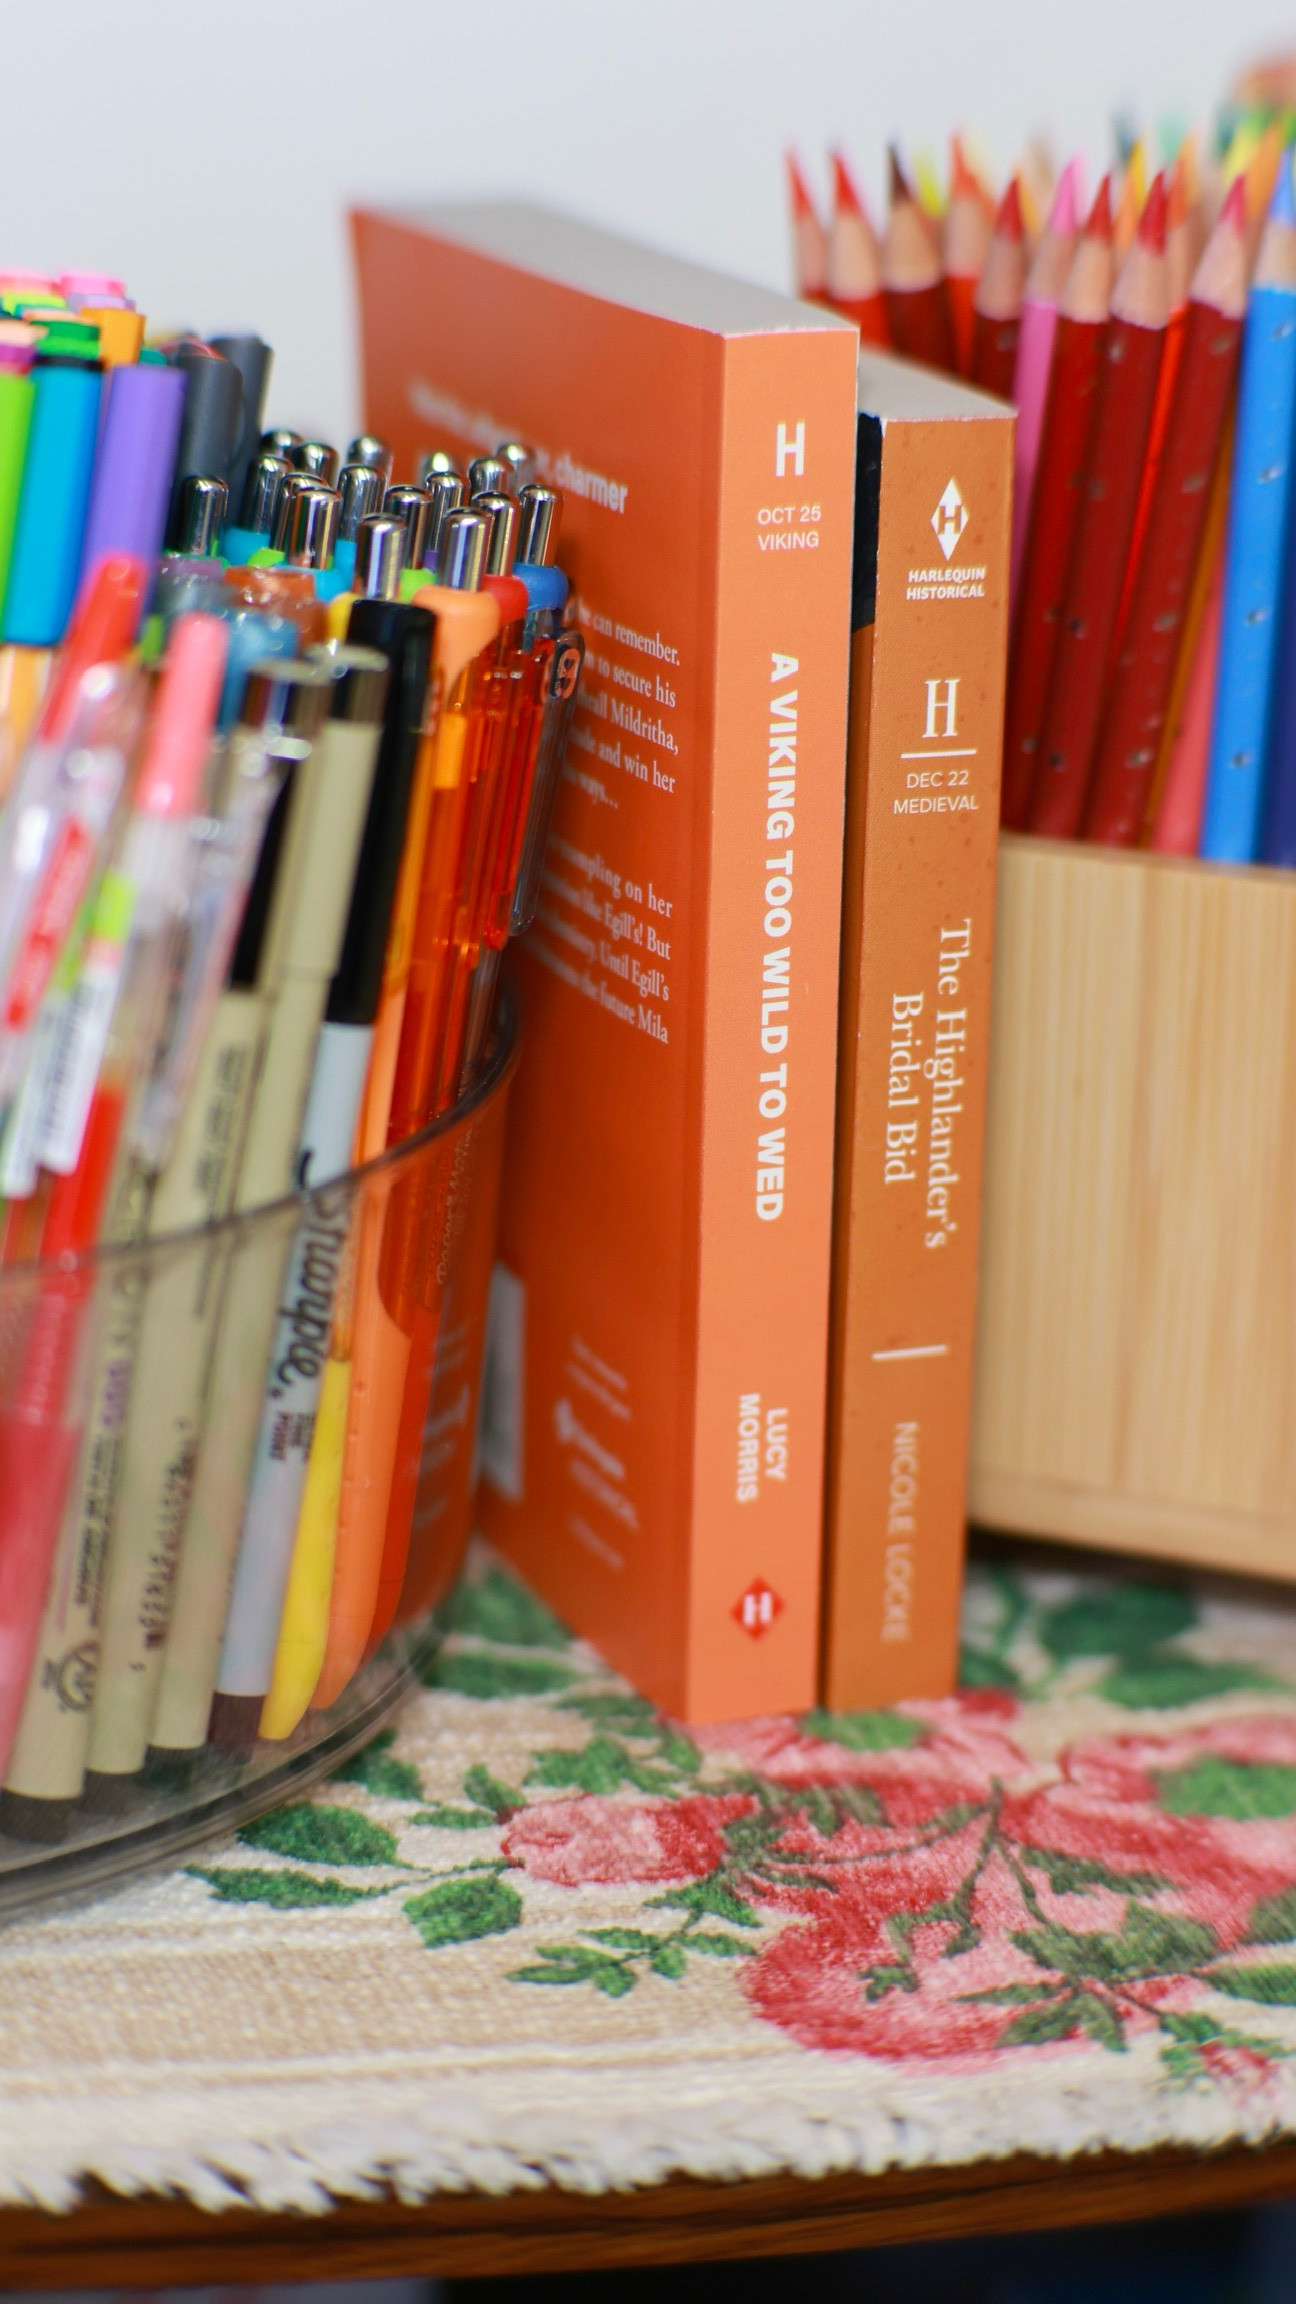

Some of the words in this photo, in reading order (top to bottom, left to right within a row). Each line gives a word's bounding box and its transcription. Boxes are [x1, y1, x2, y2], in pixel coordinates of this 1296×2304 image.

[776, 423, 806, 478] H
[553, 449, 629, 514] charmer
[757, 507, 794, 527] OCT
[800, 506, 822, 524] 25
[757, 532, 820, 553] VIKING
[937, 504, 965, 537] H
[906, 585, 985, 602] HISTORICAL
[908, 567, 986, 585] HARLEQUIN
[593, 612, 613, 637] can
[615, 624, 681, 667] remember.
[771, 652, 799, 683] A
[613, 662, 653, 698] secure
[655, 675, 677, 708] his
[922, 678, 960, 740] H
[611, 699, 679, 755] Mildritha,
[600, 742, 621, 769] and
[624, 754, 650, 783] win
[653, 760, 676, 794] her
[767, 690, 799, 841] VIKING
[906, 772, 943, 790] DEC
[948, 770, 970, 788] 22
[893, 795, 979, 815] MEDIEVAL
[624, 878, 643, 904] on
[648, 883, 674, 918] her
[764, 850, 794, 938] TOO
[599, 938, 630, 981] Until
[631, 958, 670, 1002] Egill's
[646, 925, 672, 961] But
[937, 918, 972, 996] The
[637, 1003, 670, 1045] Mila
[761, 946, 791, 1055] WILD
[887, 991, 924, 1107] Bridal
[758, 1063, 788, 1120] TO
[884, 1117, 919, 1185] Bid
[923, 1008, 967, 1249] Highlander's
[756, 1128, 786, 1222] WED
[736, 1393, 762, 1503] MORRIS
[764, 1407, 789, 1481] LUCY
[887, 1420, 919, 1536] NICOLE
[743, 1592, 773, 1627] H
[880, 1543, 915, 1644] LOCKE
